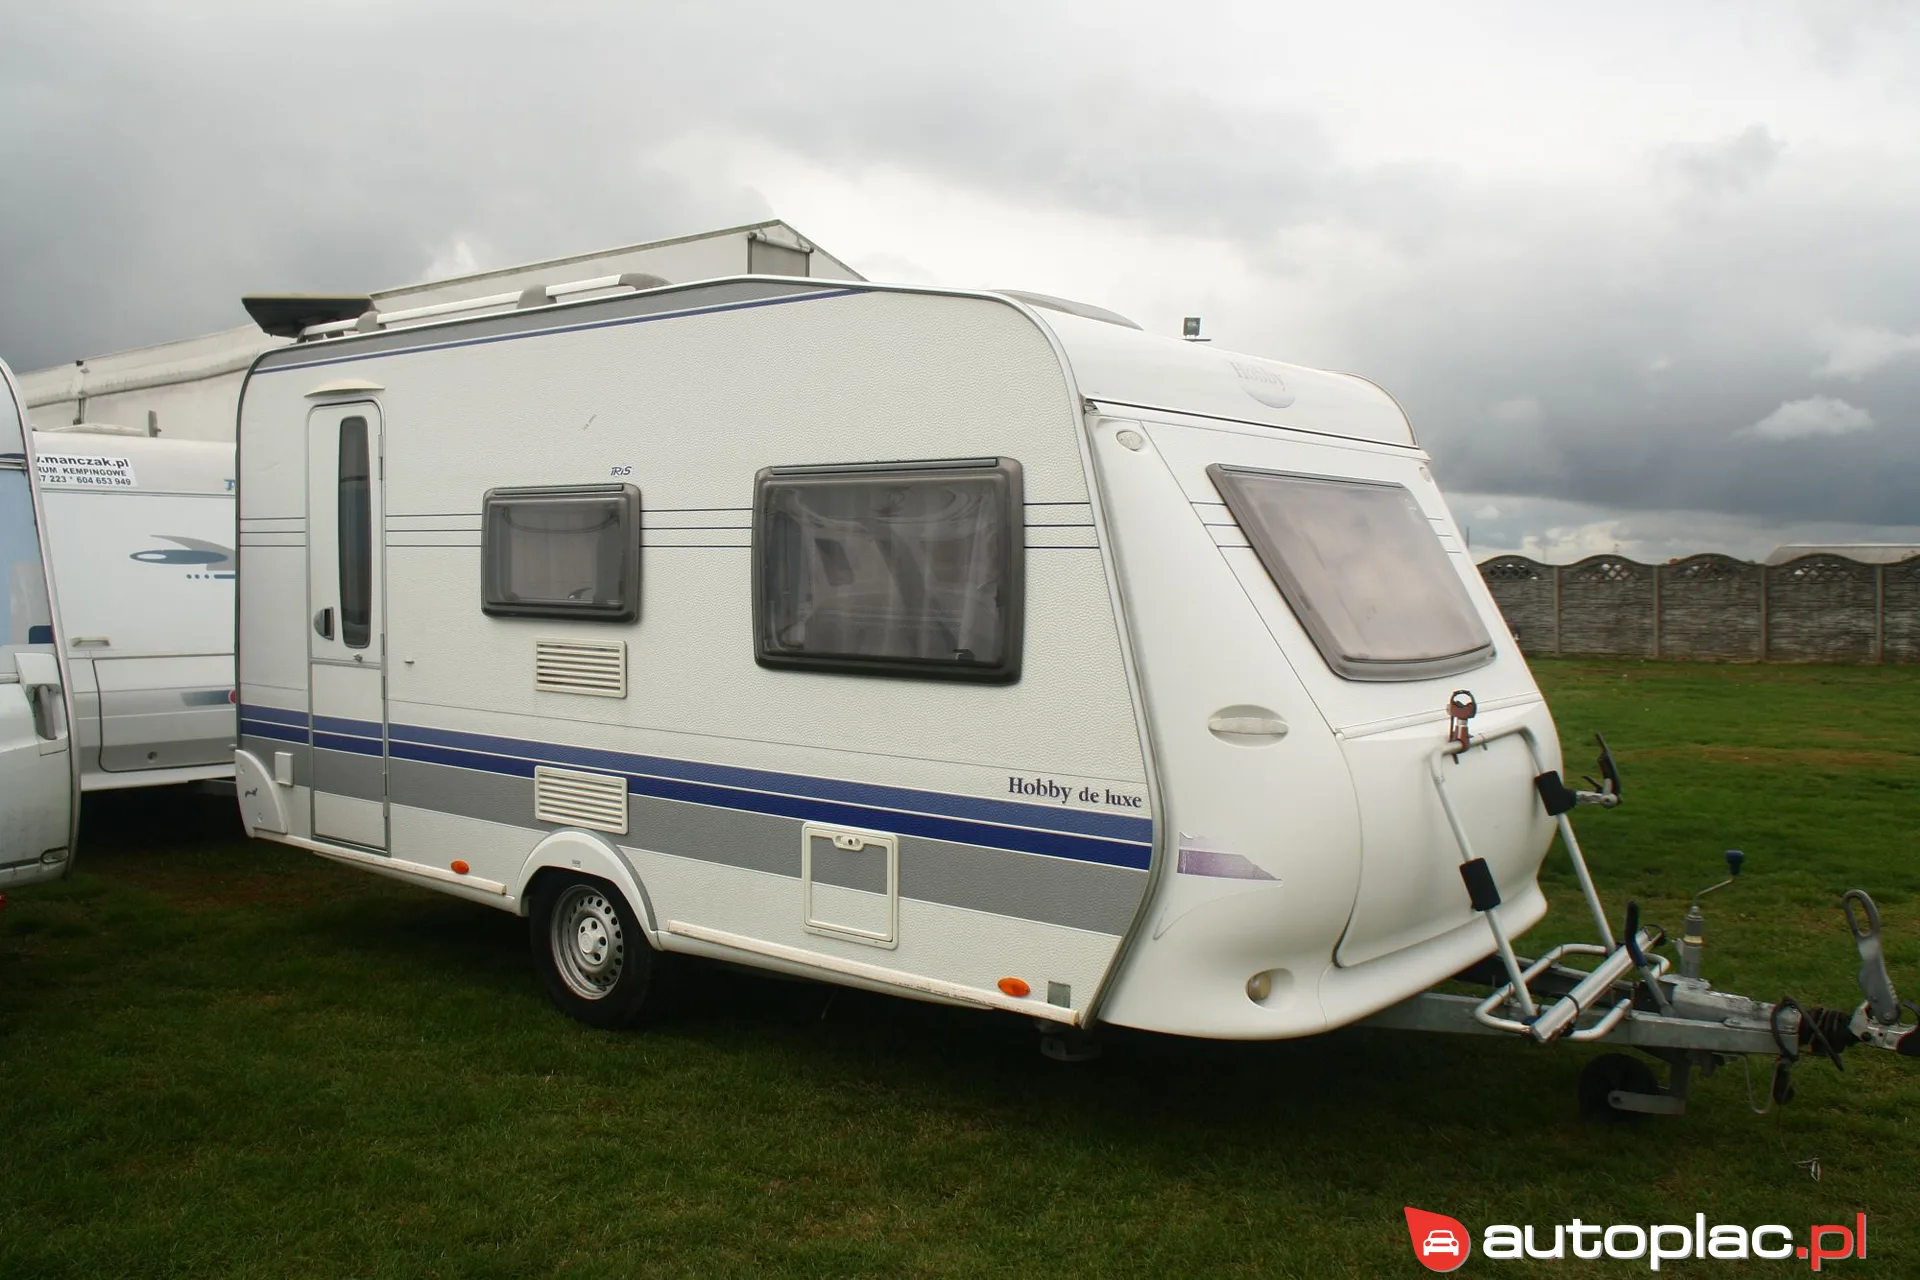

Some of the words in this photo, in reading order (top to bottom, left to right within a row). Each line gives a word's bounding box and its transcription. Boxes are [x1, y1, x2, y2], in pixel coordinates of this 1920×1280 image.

[62, 467, 127, 477] KEMPINGOWE
[49, 475, 67, 483] 223
[76, 476, 94, 484] 604
[96, 477, 113, 485] 653
[114, 478, 131, 486] 949
[1008, 777, 1072, 804] Hobby
[1078, 787, 1100, 804] de
[1105, 789, 1142, 809] luxe
